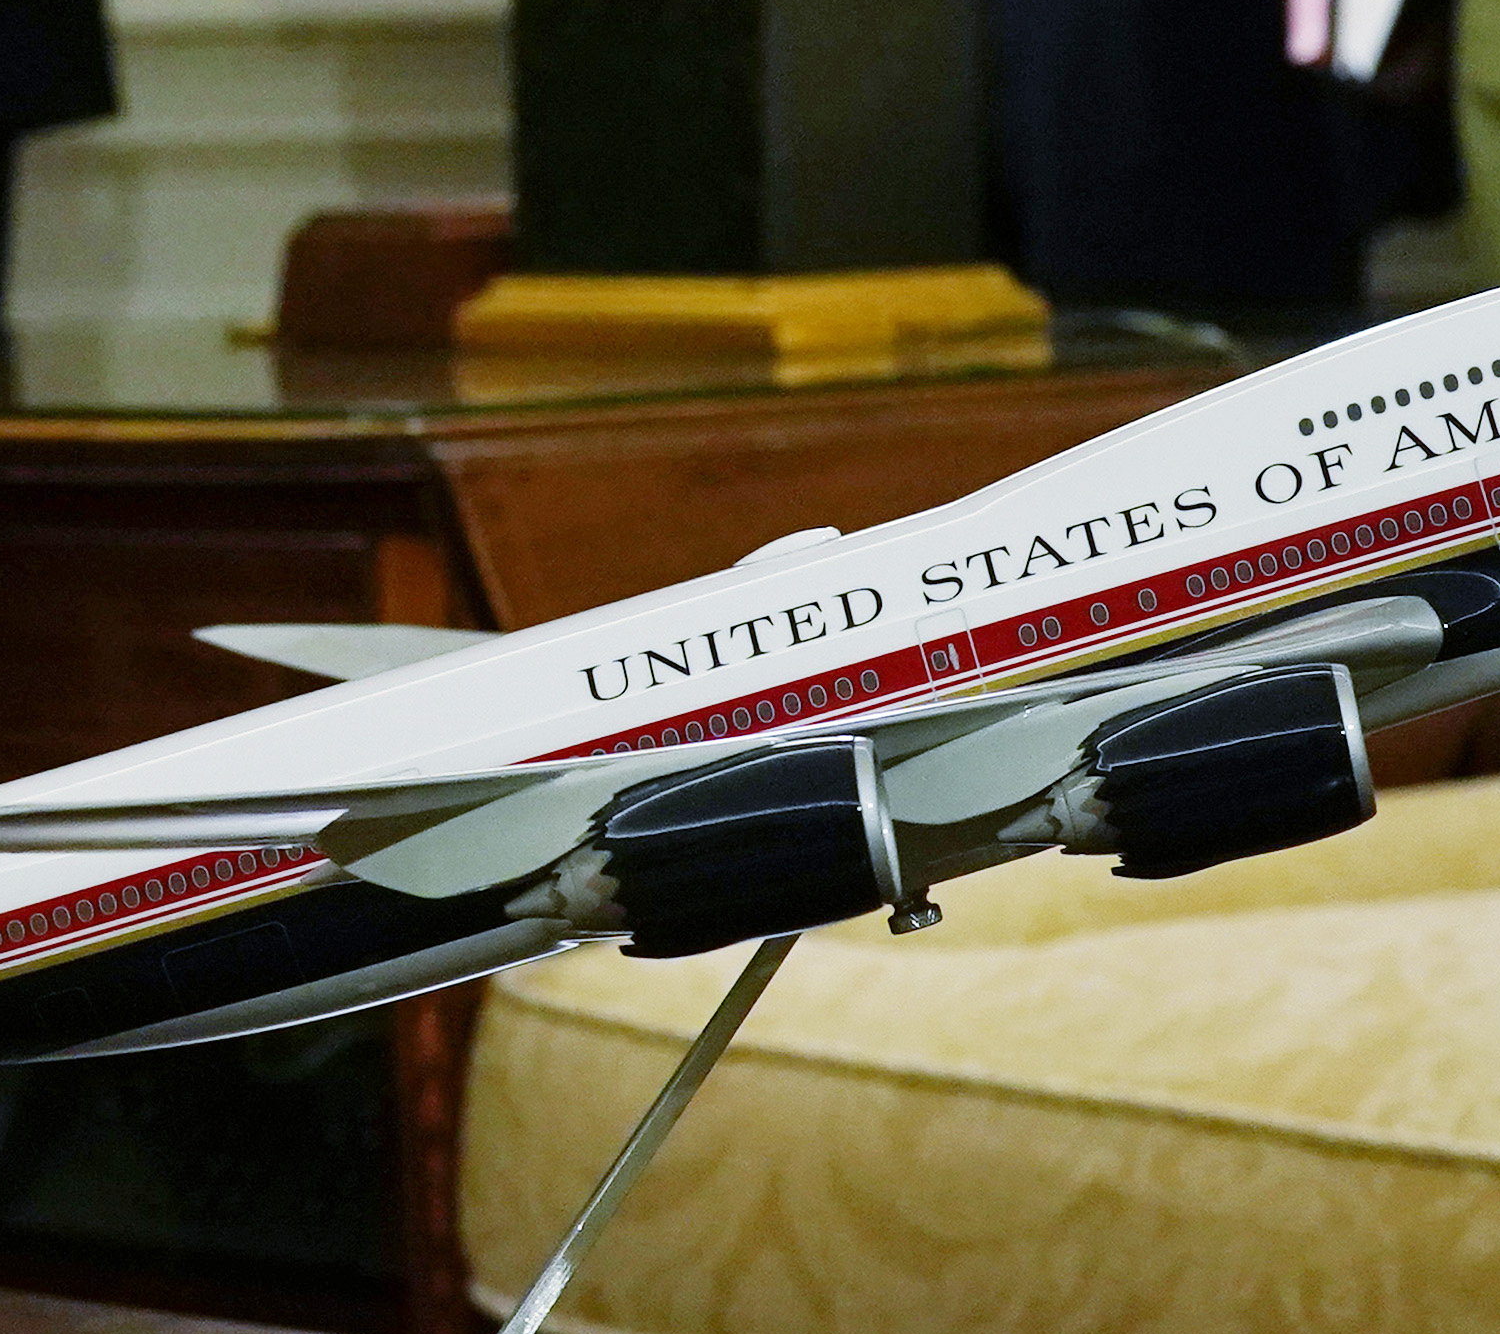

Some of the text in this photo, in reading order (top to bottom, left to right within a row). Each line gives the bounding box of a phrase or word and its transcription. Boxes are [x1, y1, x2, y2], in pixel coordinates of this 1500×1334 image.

[580, 585, 884, 703] UNITED
[921, 488, 1218, 604] STATES
[1254, 442, 1354, 506] OF
